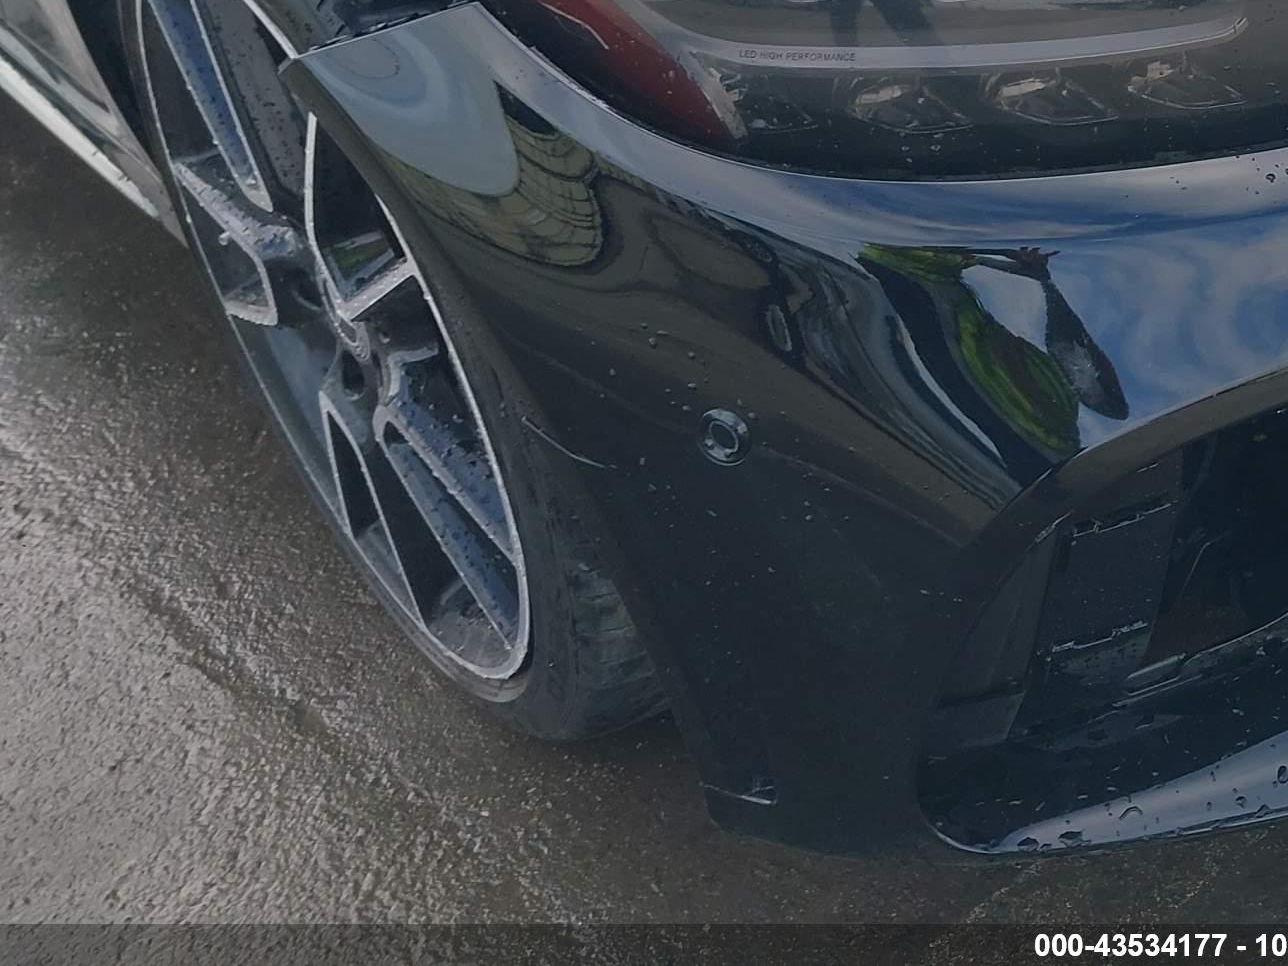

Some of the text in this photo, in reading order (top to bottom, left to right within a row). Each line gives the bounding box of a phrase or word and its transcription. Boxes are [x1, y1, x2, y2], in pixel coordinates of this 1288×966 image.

[739, 49, 857, 62] LED HIGH PERFORMANCE
